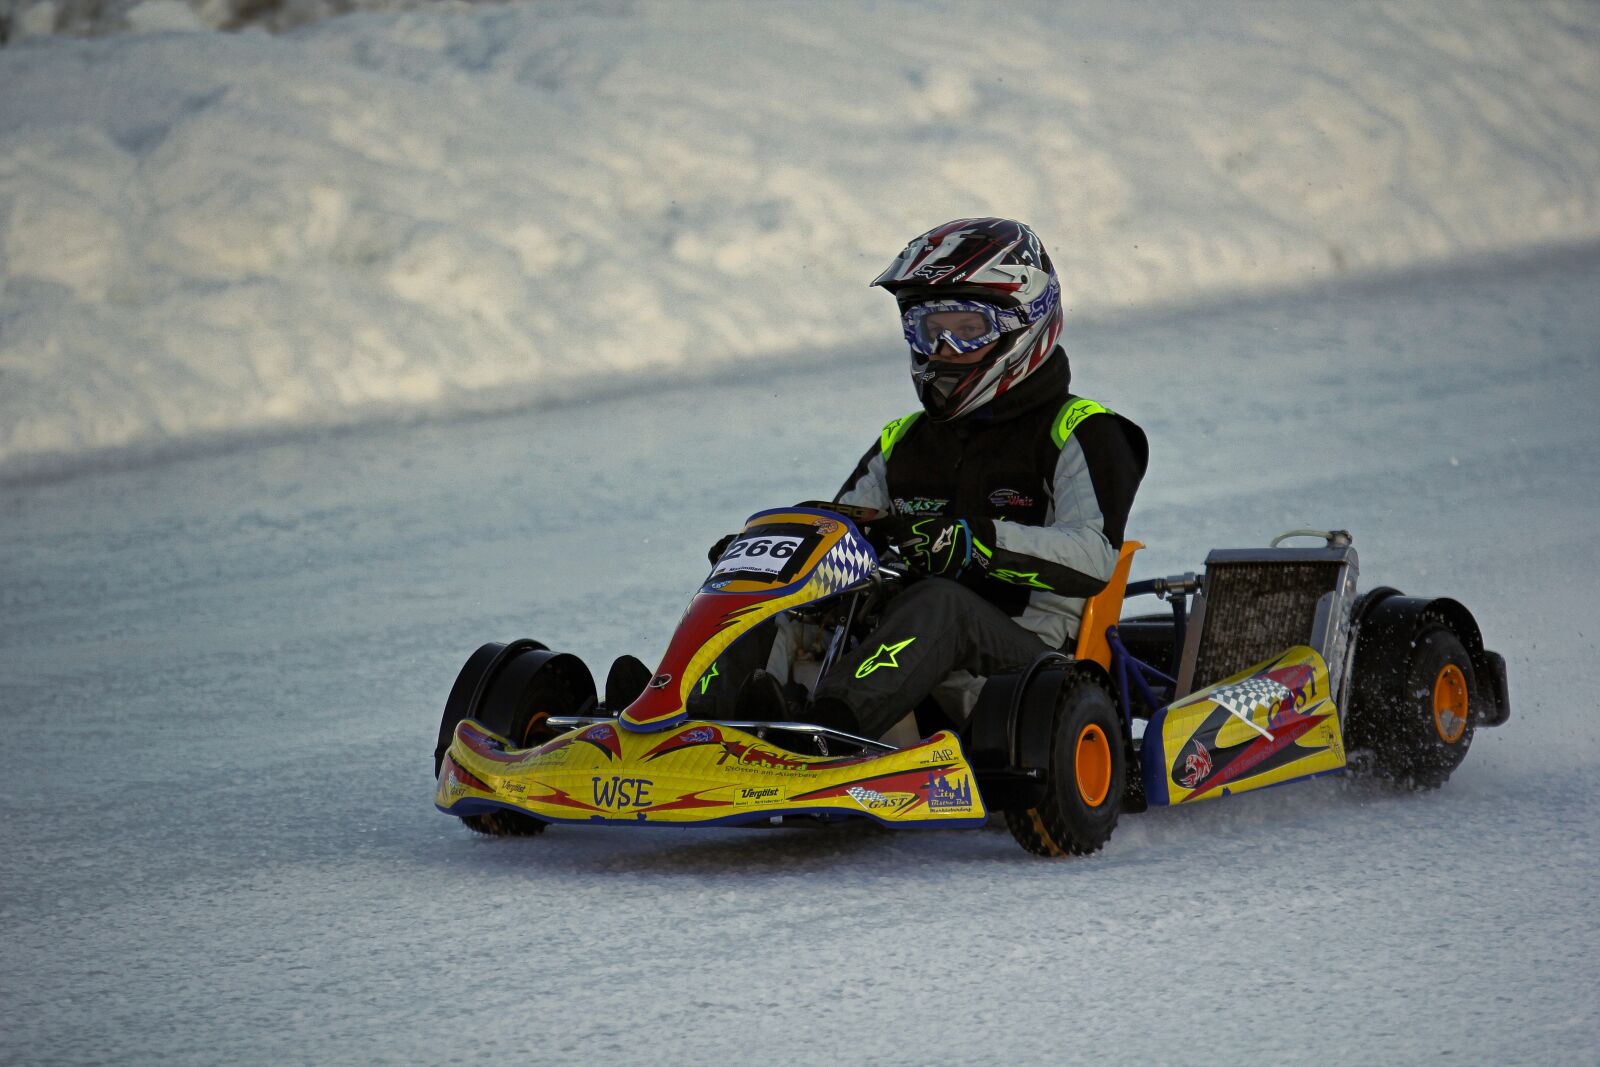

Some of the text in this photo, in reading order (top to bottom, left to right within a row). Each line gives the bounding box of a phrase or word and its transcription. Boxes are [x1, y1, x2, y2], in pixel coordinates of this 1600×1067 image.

[952, 271, 966, 282] FOX
[725, 539, 797, 559] 266
[1268, 666, 1318, 730] GAST
[592, 777, 654, 809] WSE
[741, 788, 779, 799] Vergölst
[868, 797, 908, 809] GAST
